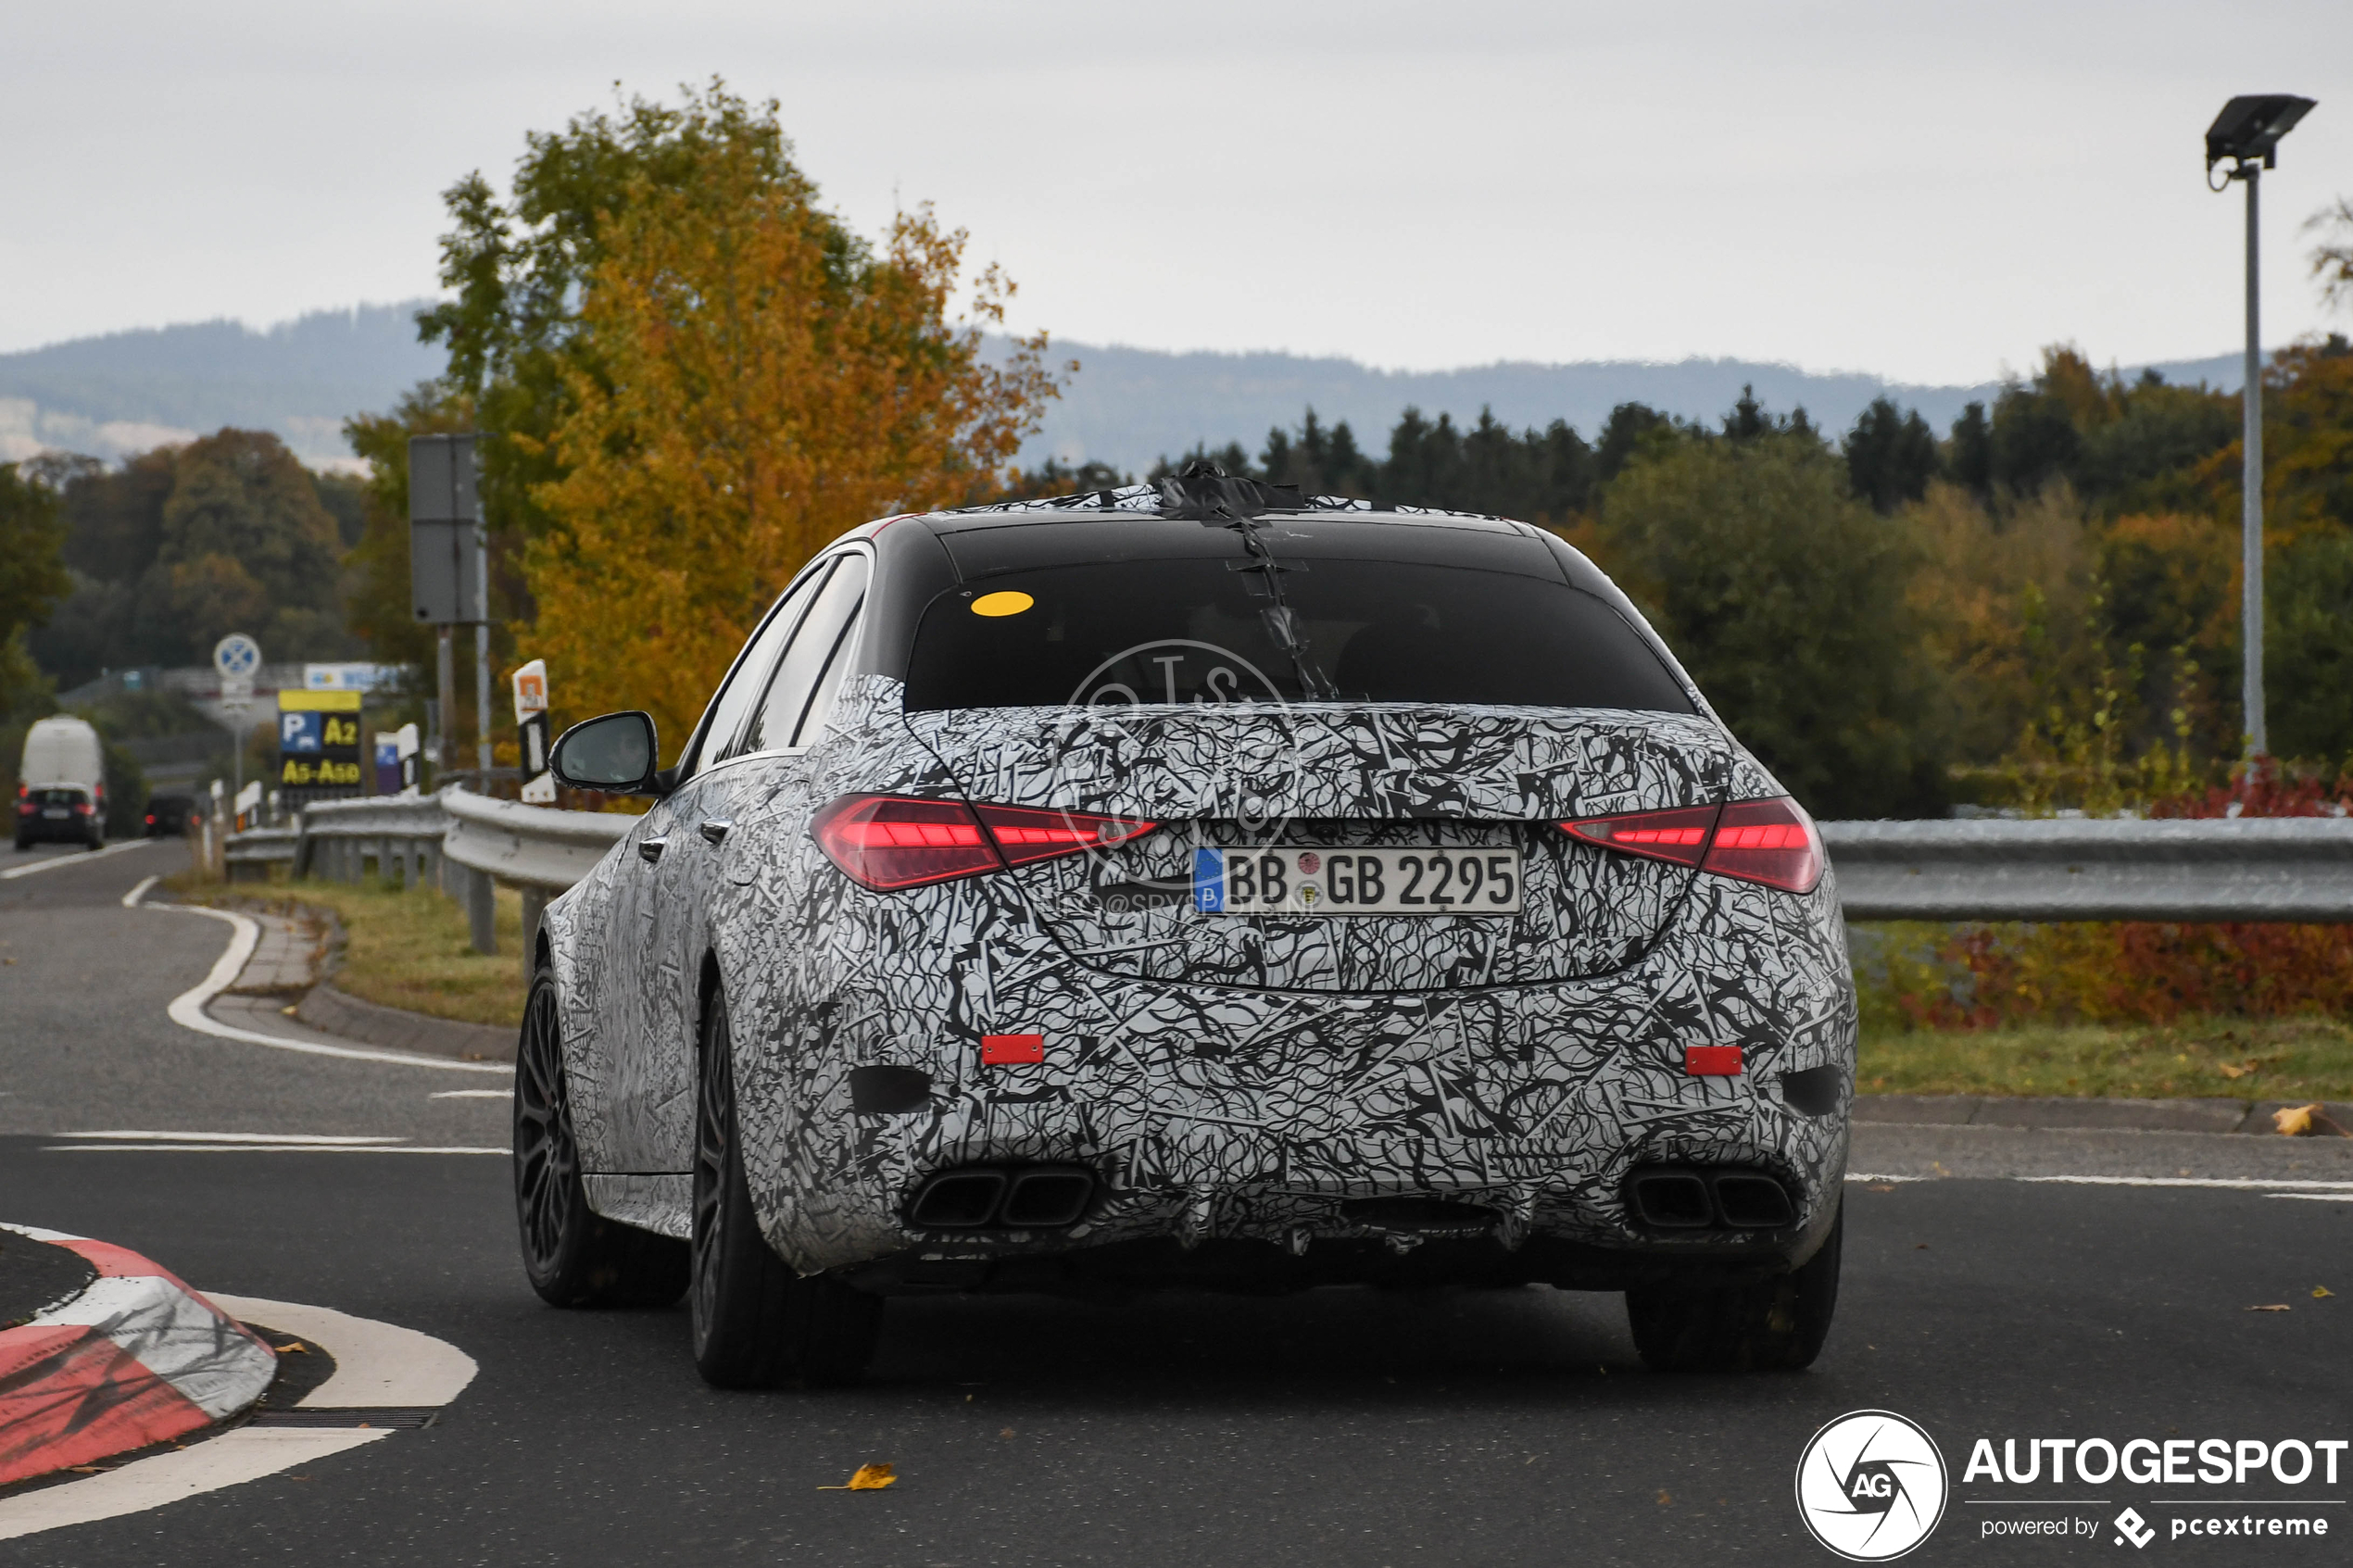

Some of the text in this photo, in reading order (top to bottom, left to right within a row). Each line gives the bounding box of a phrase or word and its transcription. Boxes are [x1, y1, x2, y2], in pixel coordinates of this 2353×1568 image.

[283, 713, 358, 746] P A2
[1228, 855, 1515, 905] BB GB 2295
